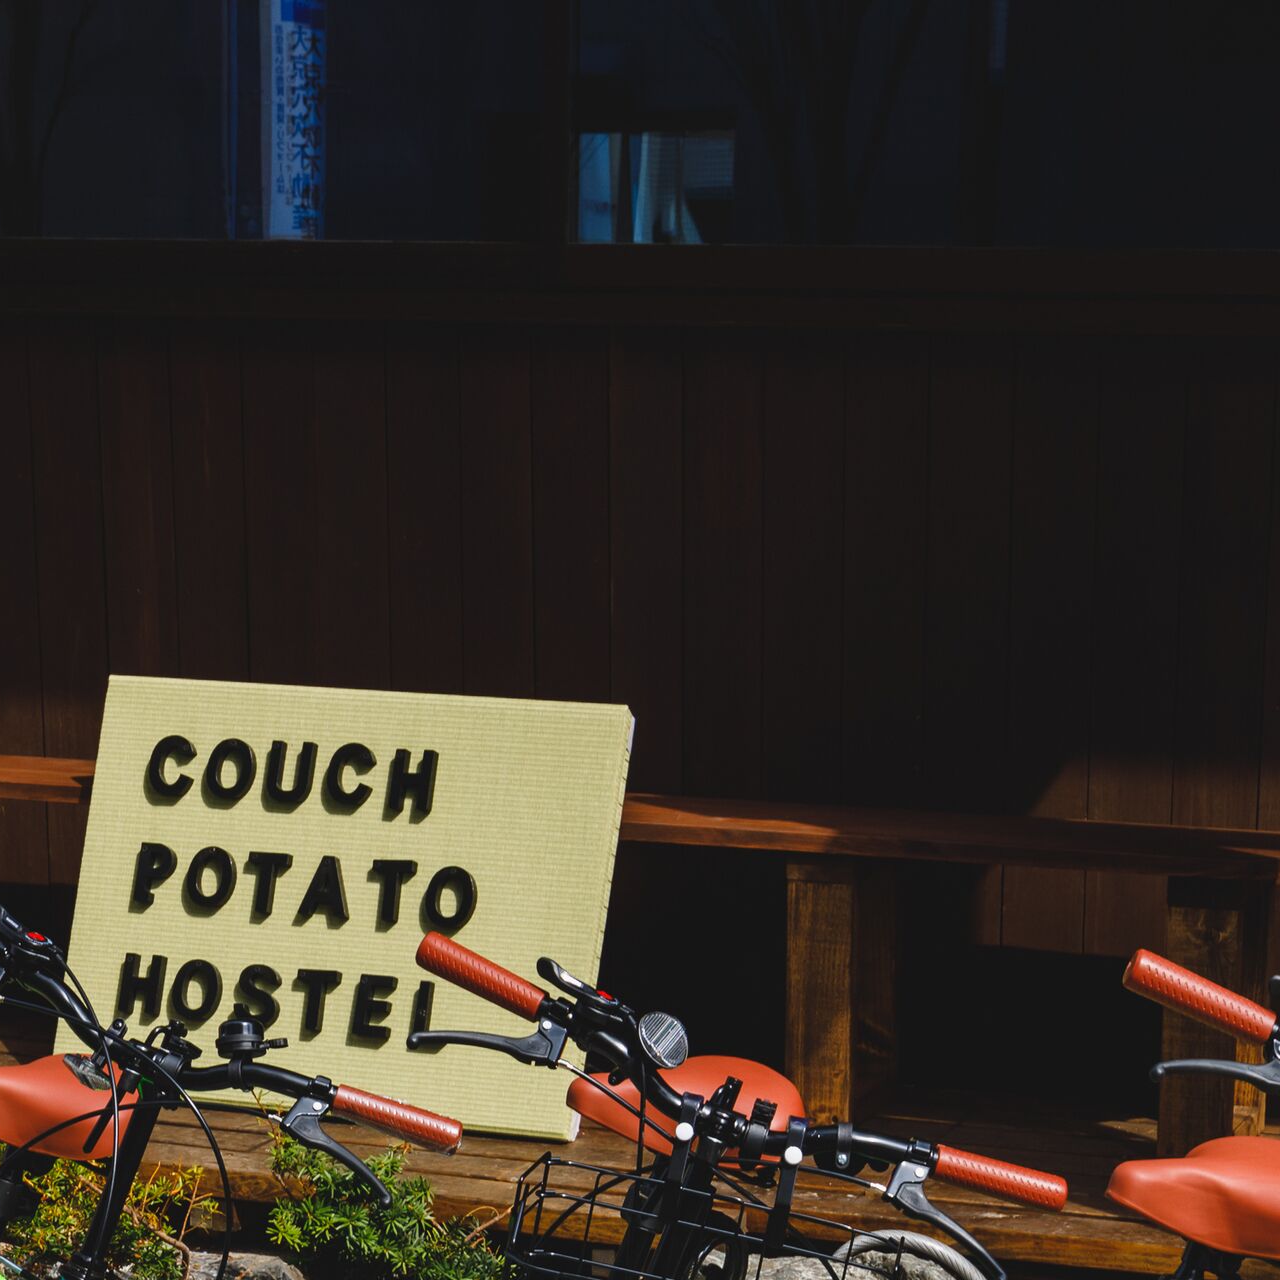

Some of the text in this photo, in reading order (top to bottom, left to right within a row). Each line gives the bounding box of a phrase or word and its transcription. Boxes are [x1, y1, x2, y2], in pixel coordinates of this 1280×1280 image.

[145, 735, 439, 817] COUCH
[131, 842, 478, 932] POTATO
[117, 953, 436, 1045] HOSTEL
